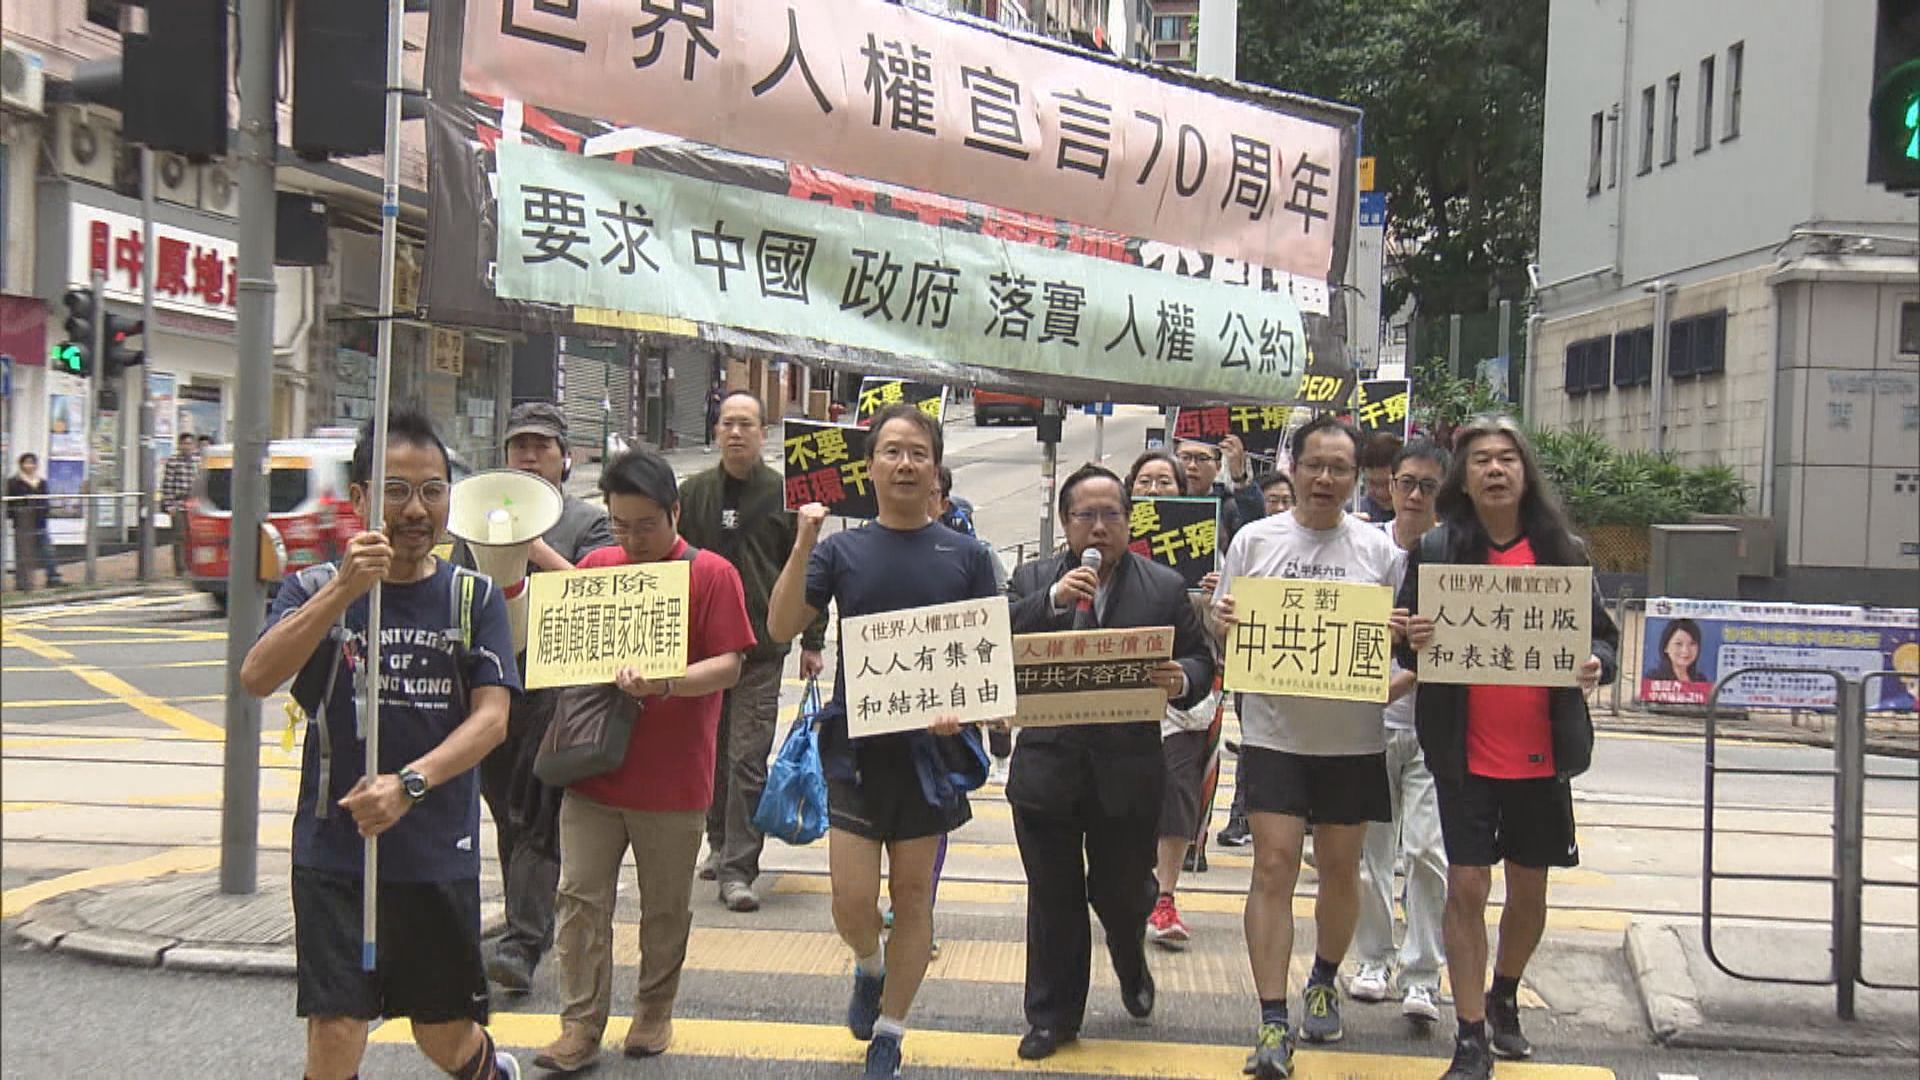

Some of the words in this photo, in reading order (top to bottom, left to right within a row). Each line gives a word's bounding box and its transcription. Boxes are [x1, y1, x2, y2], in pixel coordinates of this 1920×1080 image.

[115, 229, 238, 306] 中原地
[784, 427, 849, 471] 不要
[786, 460, 869, 509] 西環干
[1128, 499, 1160, 537] 要
[561, 570, 660, 599] 廢除
[1281, 587, 1340, 612] 反對
[1438, 573, 1573, 595] 《世界人權宣言》
[861, 608, 989, 642] 《世界人權宣言》
[1433, 602, 1579, 631] 人人有出版
[856, 636, 998, 679] 人人有集會
[1020, 634, 1165, 659] 人權普世價值
[1235, 610, 1386, 680] 中共打壓
[1428, 644, 1575, 671] 和表達自由
[390, 653, 414, 670] OF
[404, 677, 452, 695] KONG
[857, 678, 999, 721] 和結社自由
